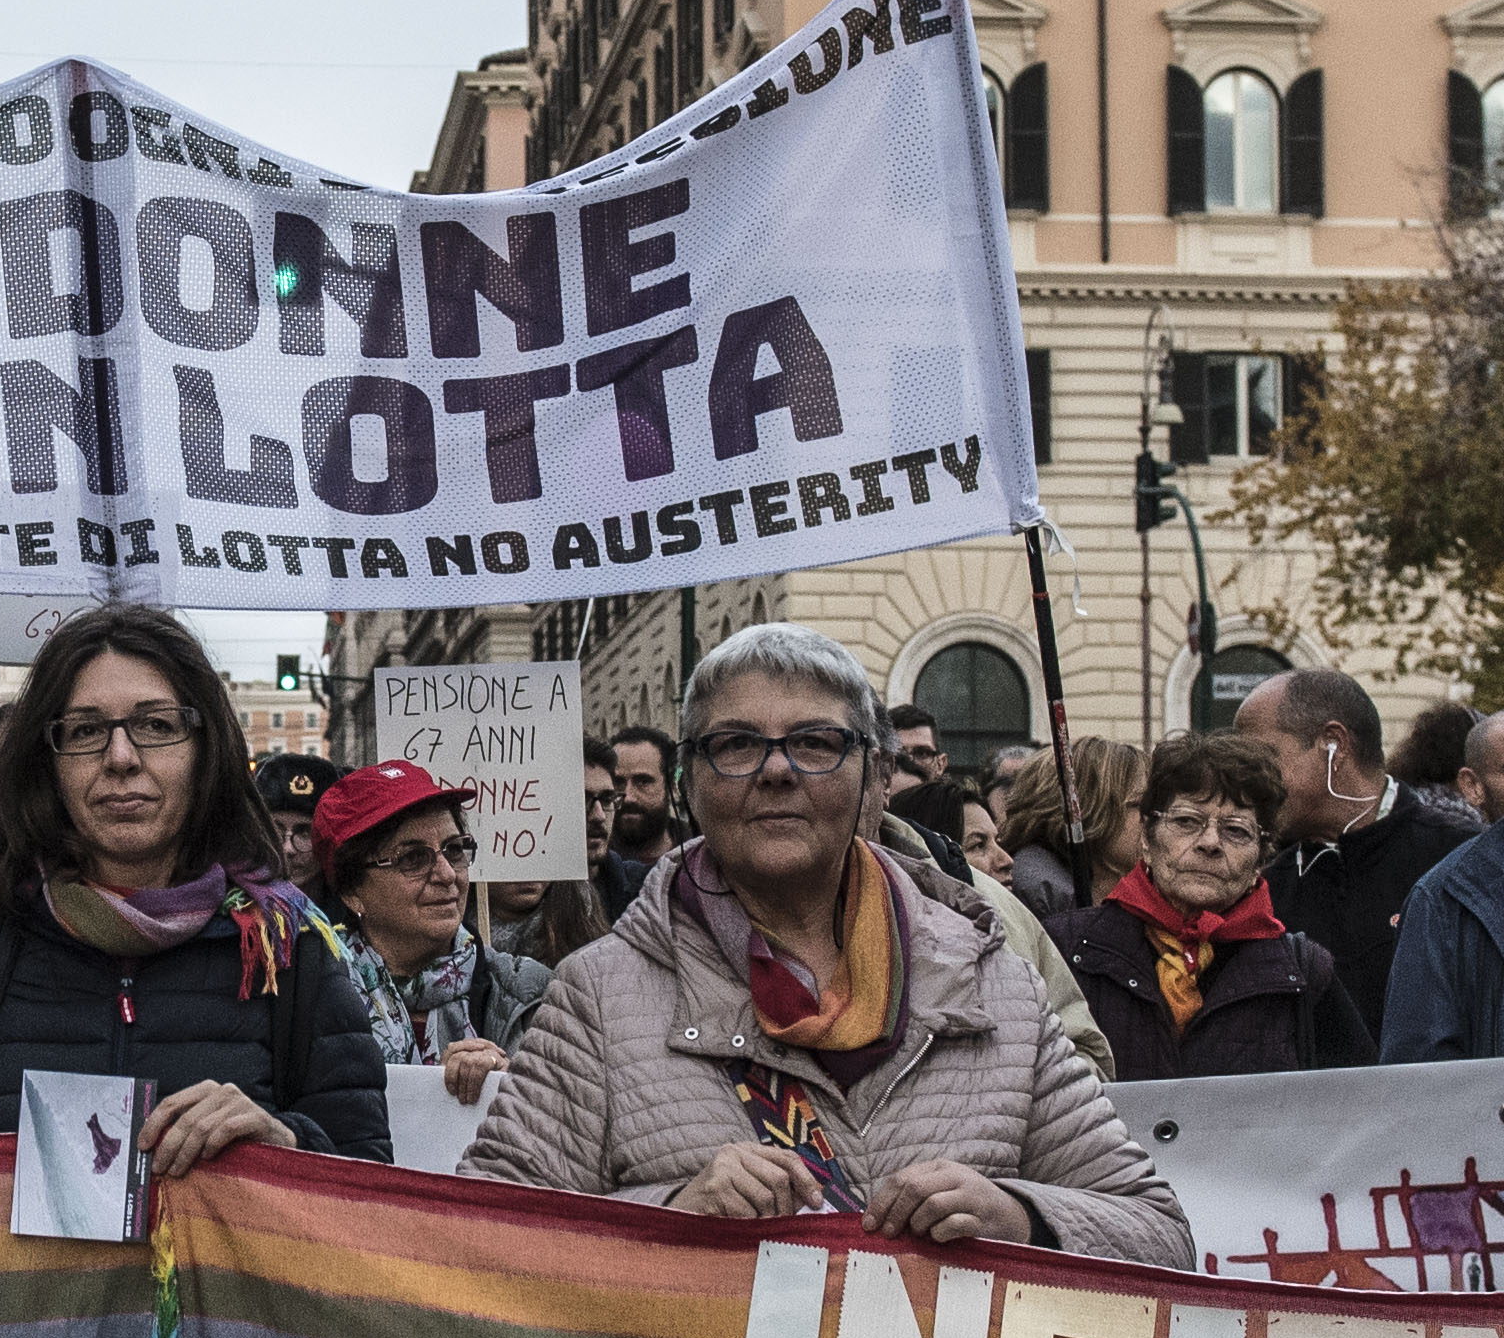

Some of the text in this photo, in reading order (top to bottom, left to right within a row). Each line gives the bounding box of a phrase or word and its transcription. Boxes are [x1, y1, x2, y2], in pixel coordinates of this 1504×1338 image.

[172, 294, 844, 517] LOTTA
[77, 516, 160, 567] DI
[176, 523, 407, 580] LOTTA
[425, 531, 529, 577] NO
[551, 435, 984, 572] AUSTERITY
[386, 673, 568, 716] PENSIONE A
[403, 725, 536, 764] 67 ANNI
[492, 815, 553, 858] NO!
